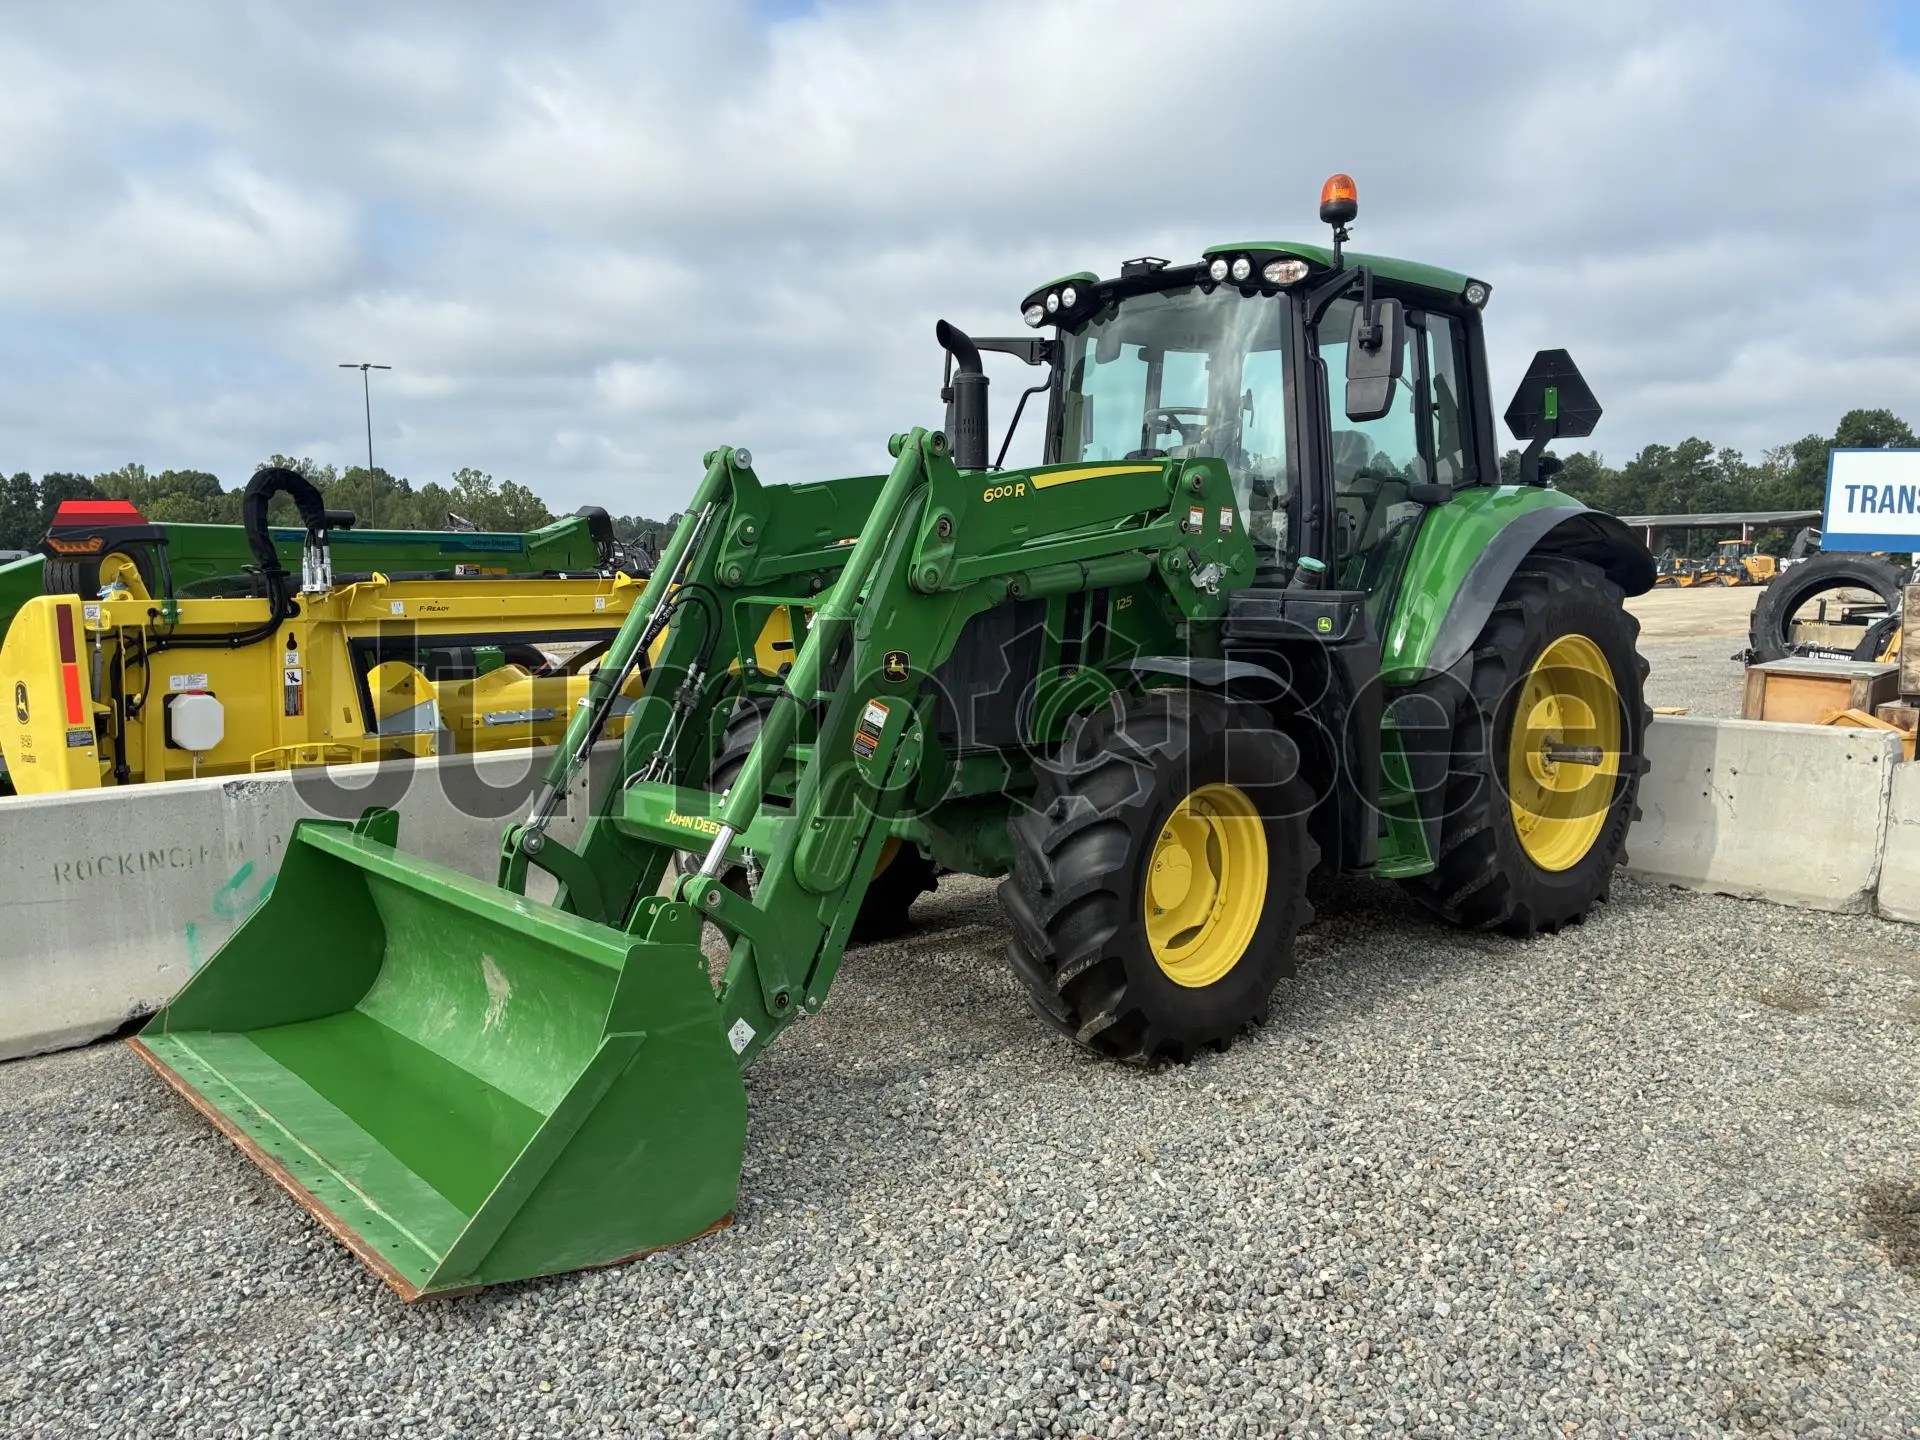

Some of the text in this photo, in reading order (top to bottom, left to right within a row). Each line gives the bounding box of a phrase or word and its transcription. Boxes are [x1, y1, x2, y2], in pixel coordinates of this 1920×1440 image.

[983, 483, 1025, 503] 600 R
[665, 809, 694, 828] JOHN
